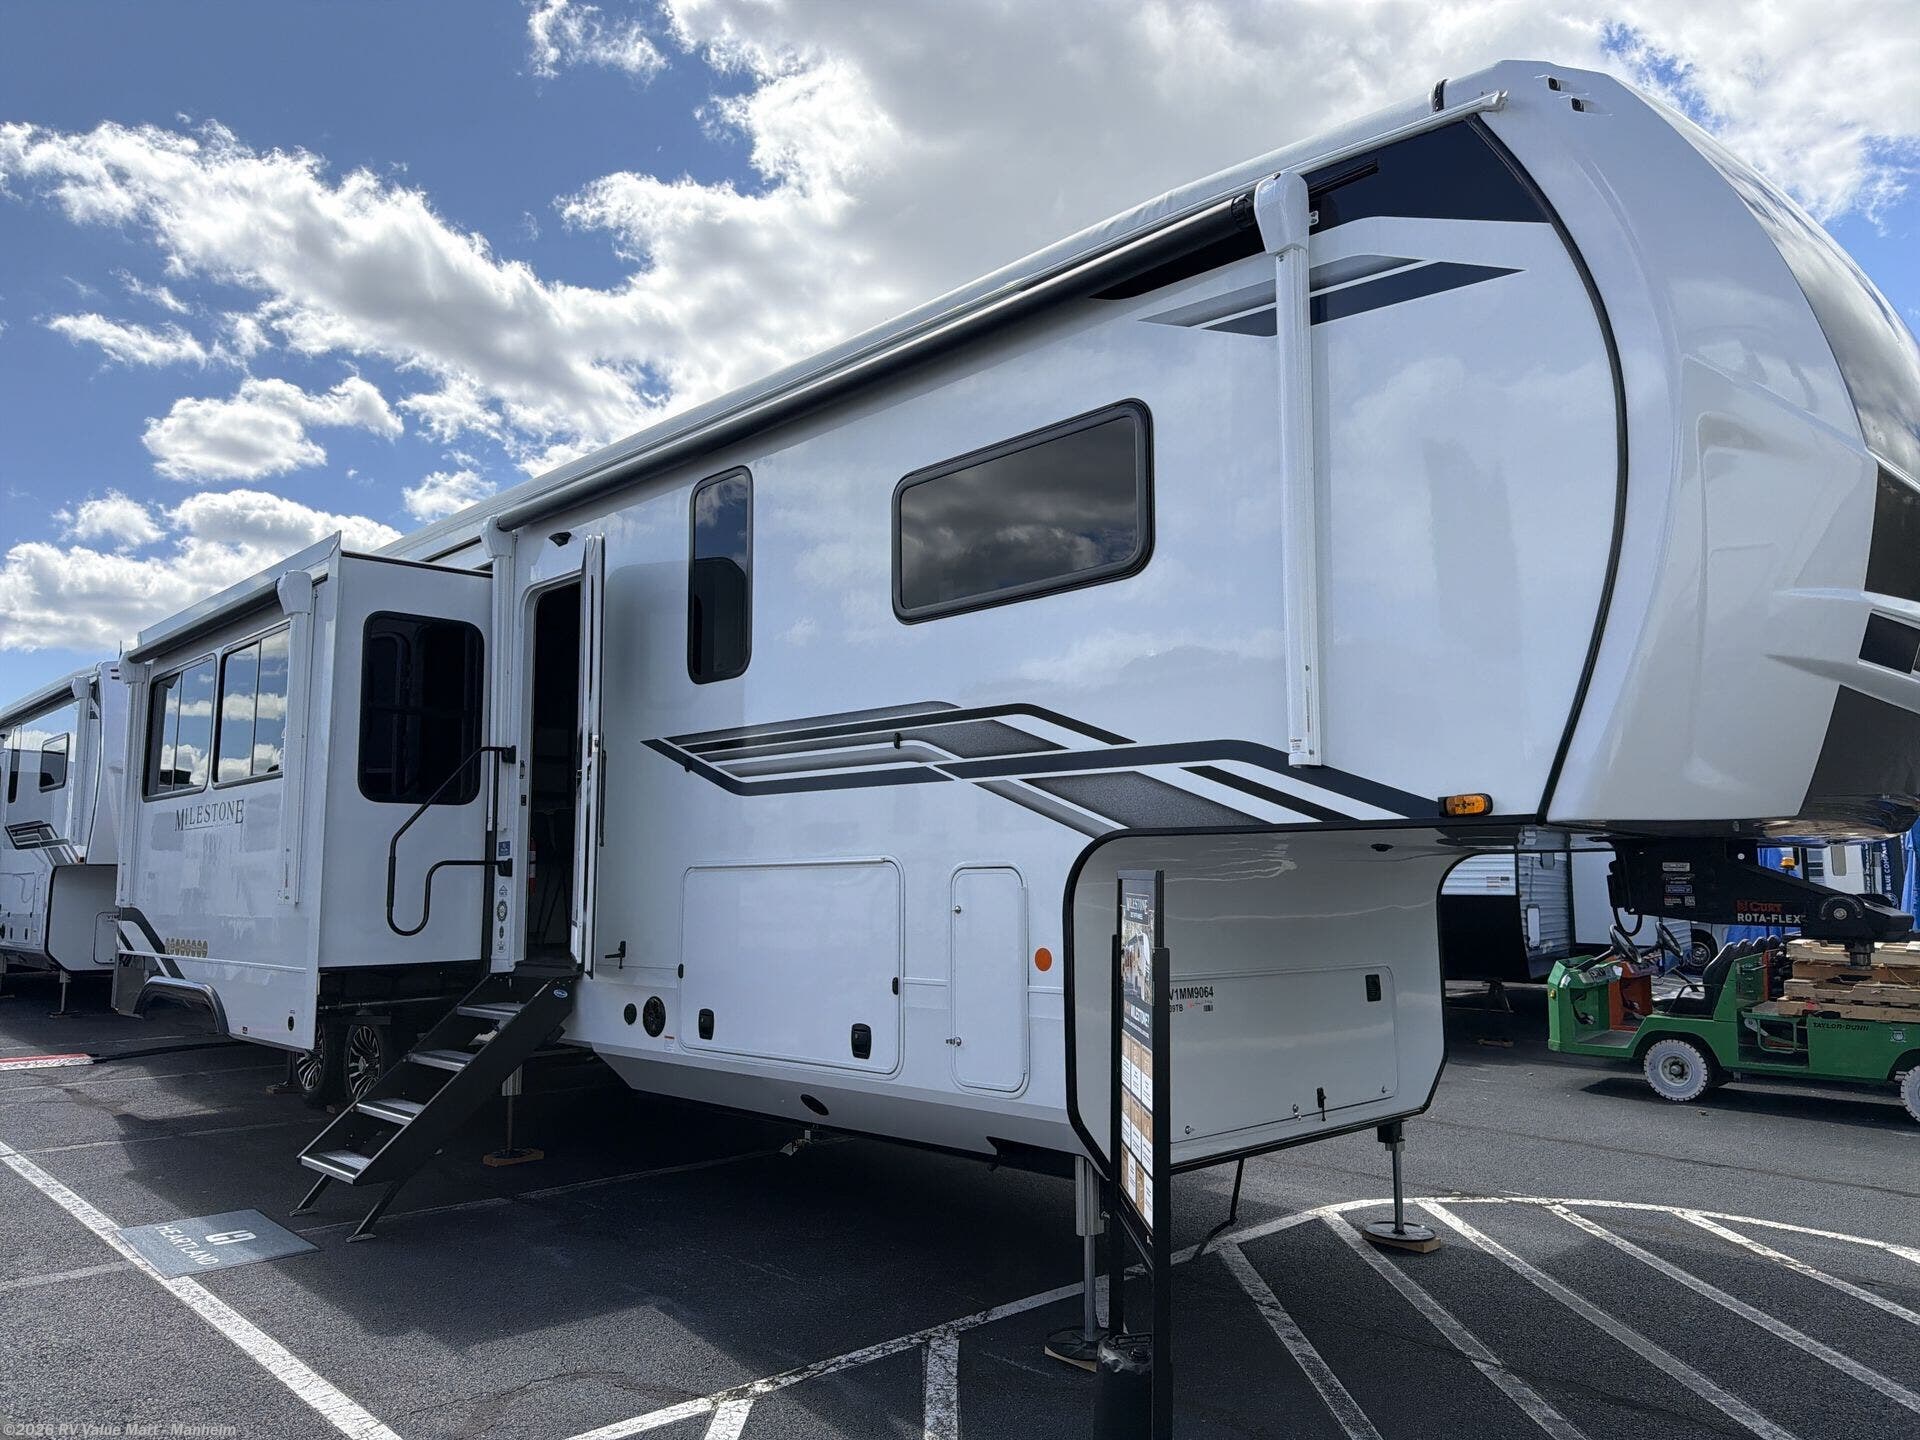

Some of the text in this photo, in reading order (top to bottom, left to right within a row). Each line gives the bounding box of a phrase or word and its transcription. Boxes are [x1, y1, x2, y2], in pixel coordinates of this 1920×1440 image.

[174, 799, 244, 831] MILESTONE
[1884, 875, 1892, 891] BLUE
[154, 1224, 220, 1266] HEARTLAND
